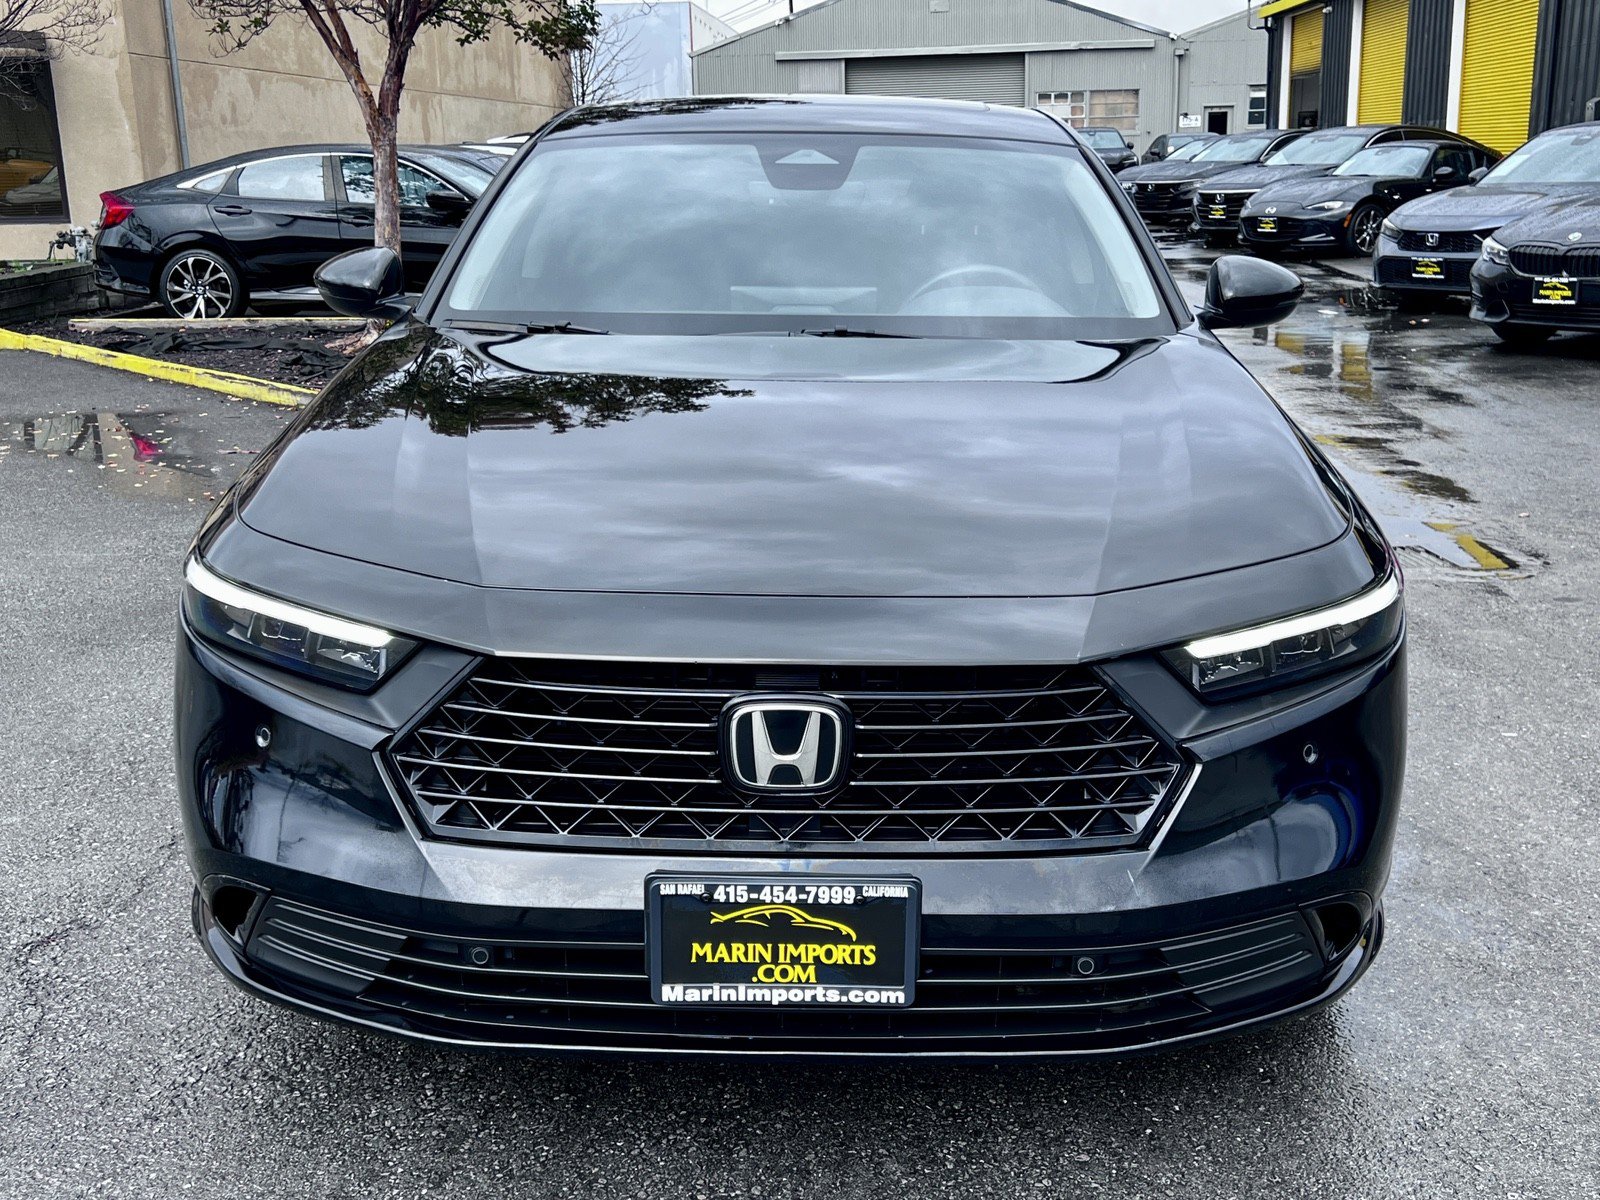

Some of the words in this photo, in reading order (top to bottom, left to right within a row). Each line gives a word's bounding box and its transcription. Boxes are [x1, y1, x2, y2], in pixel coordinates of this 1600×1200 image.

[660, 884, 676, 895] SAN
[677, 884, 705, 896] RAFAEL
[713, 885, 856, 904] 415-454-7999
[862, 886, 909, 898] CALIFORNIA
[690, 942, 772, 963] MARIN
[778, 943, 877, 966] IMPORTS
[751, 964, 817, 984] .COM
[661, 984, 906, 1005] MarinImports.com
